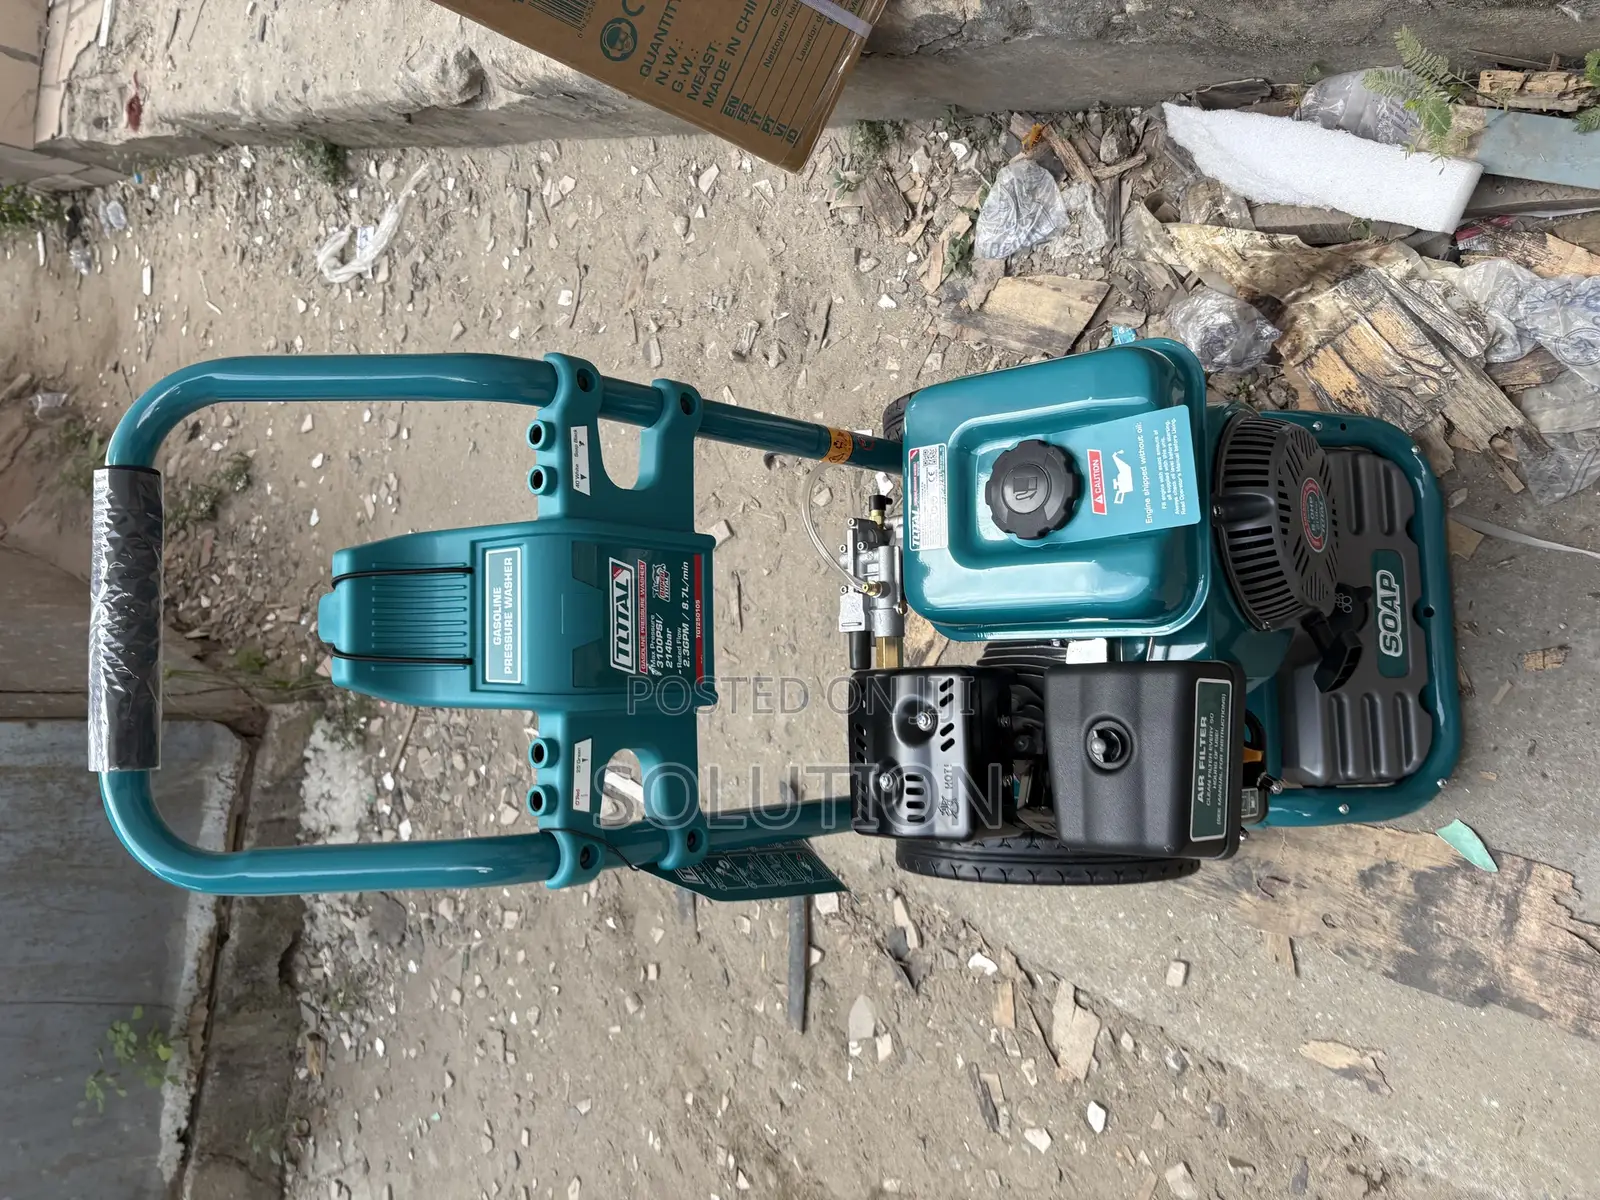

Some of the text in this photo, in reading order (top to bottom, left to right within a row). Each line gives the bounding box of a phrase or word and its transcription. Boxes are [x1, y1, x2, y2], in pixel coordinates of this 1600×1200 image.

[686, 40, 722, 100] MEAST:
[702, 59, 732, 108] MADE
[726, 36, 741, 56] IN
[736, 103, 752, 124] FR
[763, 20, 789, 68] Nettoyeur
[761, 116, 775, 136] PT
[796, 24, 818, 62] Lavador
[724, 96, 740, 118] EN
[750, 110, 762, 125] IT
[774, 124, 787, 137] VI
[786, 128, 799, 144] ID
[1137, 436, 1146, 464] without
[1092, 459, 1102, 494] CAUTION
[1140, 466, 1150, 496] shipped
[912, 508, 920, 546] TOTAL
[1145, 498, 1154, 524] Engine
[681, 562, 689, 610] 8.7L/min
[493, 586, 502, 646] GASOLINE
[504, 557, 513, 674] PRESSURE WASHER
[615, 579, 632, 667] TOTAL
[1376, 570, 1402, 657] SOAP
[656, 612, 664, 668] 3100PSI/
[1210, 712, 1214, 724] 50
[1214, 750, 1218, 760] OF
